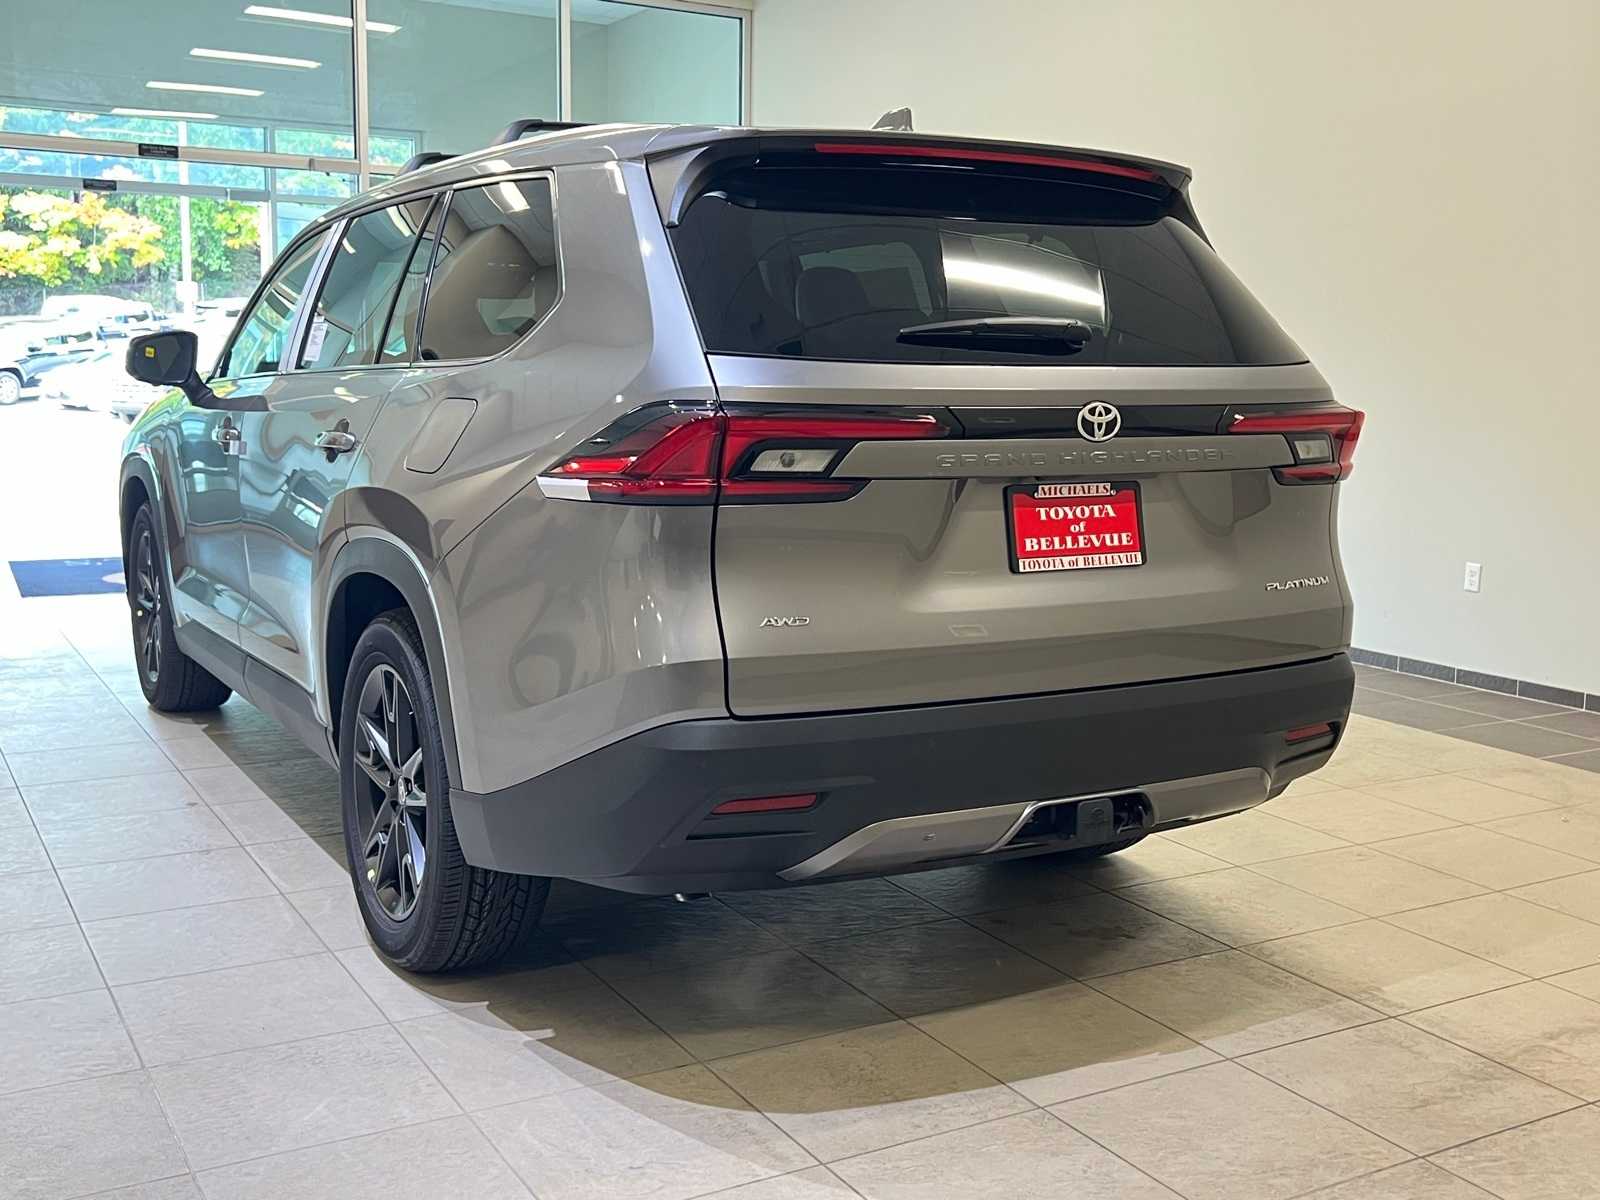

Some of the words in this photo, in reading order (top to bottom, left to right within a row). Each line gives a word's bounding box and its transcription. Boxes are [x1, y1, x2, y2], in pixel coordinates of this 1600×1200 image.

[1039, 484, 1110, 497] MICHAELS
[1036, 504, 1116, 521] TOYOTA
[1070, 521, 1087, 533] of
[1024, 532, 1133, 552] BELLEVUE
[1020, 557, 1065, 571] TOYOTA
[1068, 557, 1080, 568] of
[1083, 553, 1141, 567] BELLEVUE
[1265, 576, 1329, 591] PLATINUM
[760, 616, 810, 627] AWD
